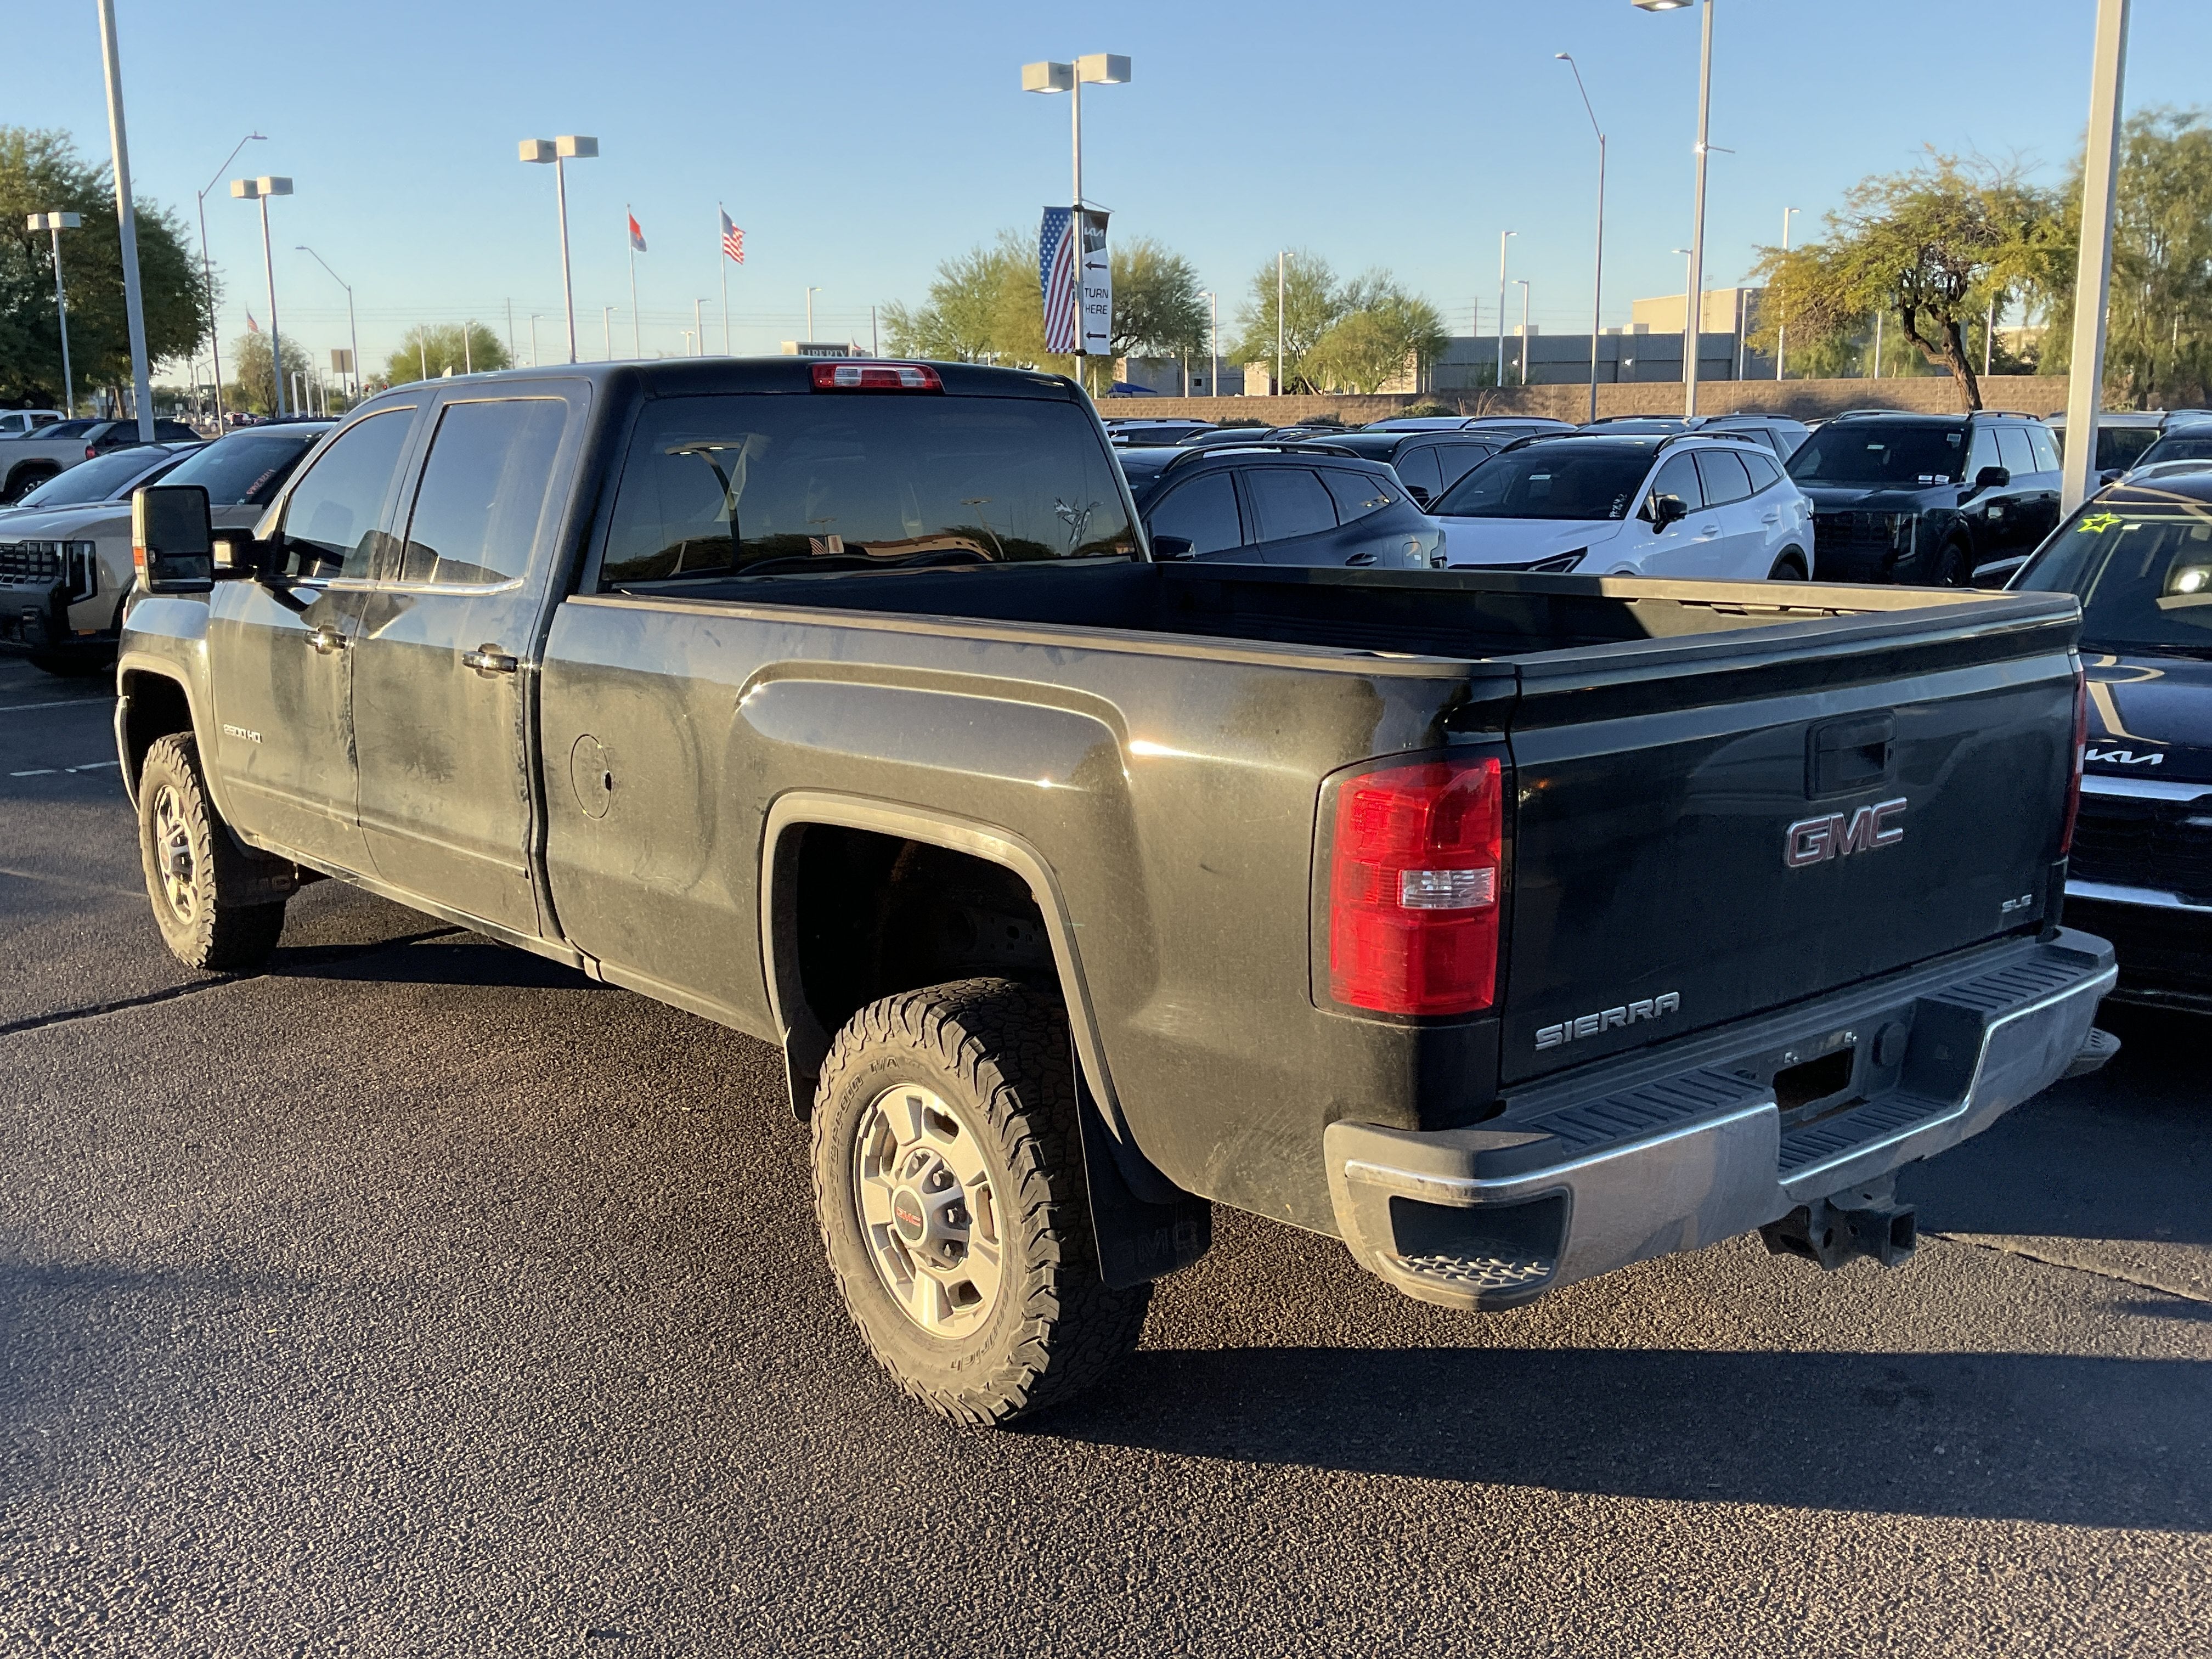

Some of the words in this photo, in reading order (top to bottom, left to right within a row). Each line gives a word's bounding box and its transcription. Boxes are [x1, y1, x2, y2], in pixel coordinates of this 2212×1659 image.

[1084, 287, 1109, 298] TURN
[1085, 304, 1108, 315] HERE
[800, 349, 848, 357] LIBERTY
[2085, 748, 2164, 765] KIA
[1786, 797, 1908, 868] GMC
[2002, 894, 2032, 913] SLE
[1535, 991, 1680, 1051] SIERRA
[868, 1055, 901, 1076] T/A
[895, 1206, 921, 1227] GMC
